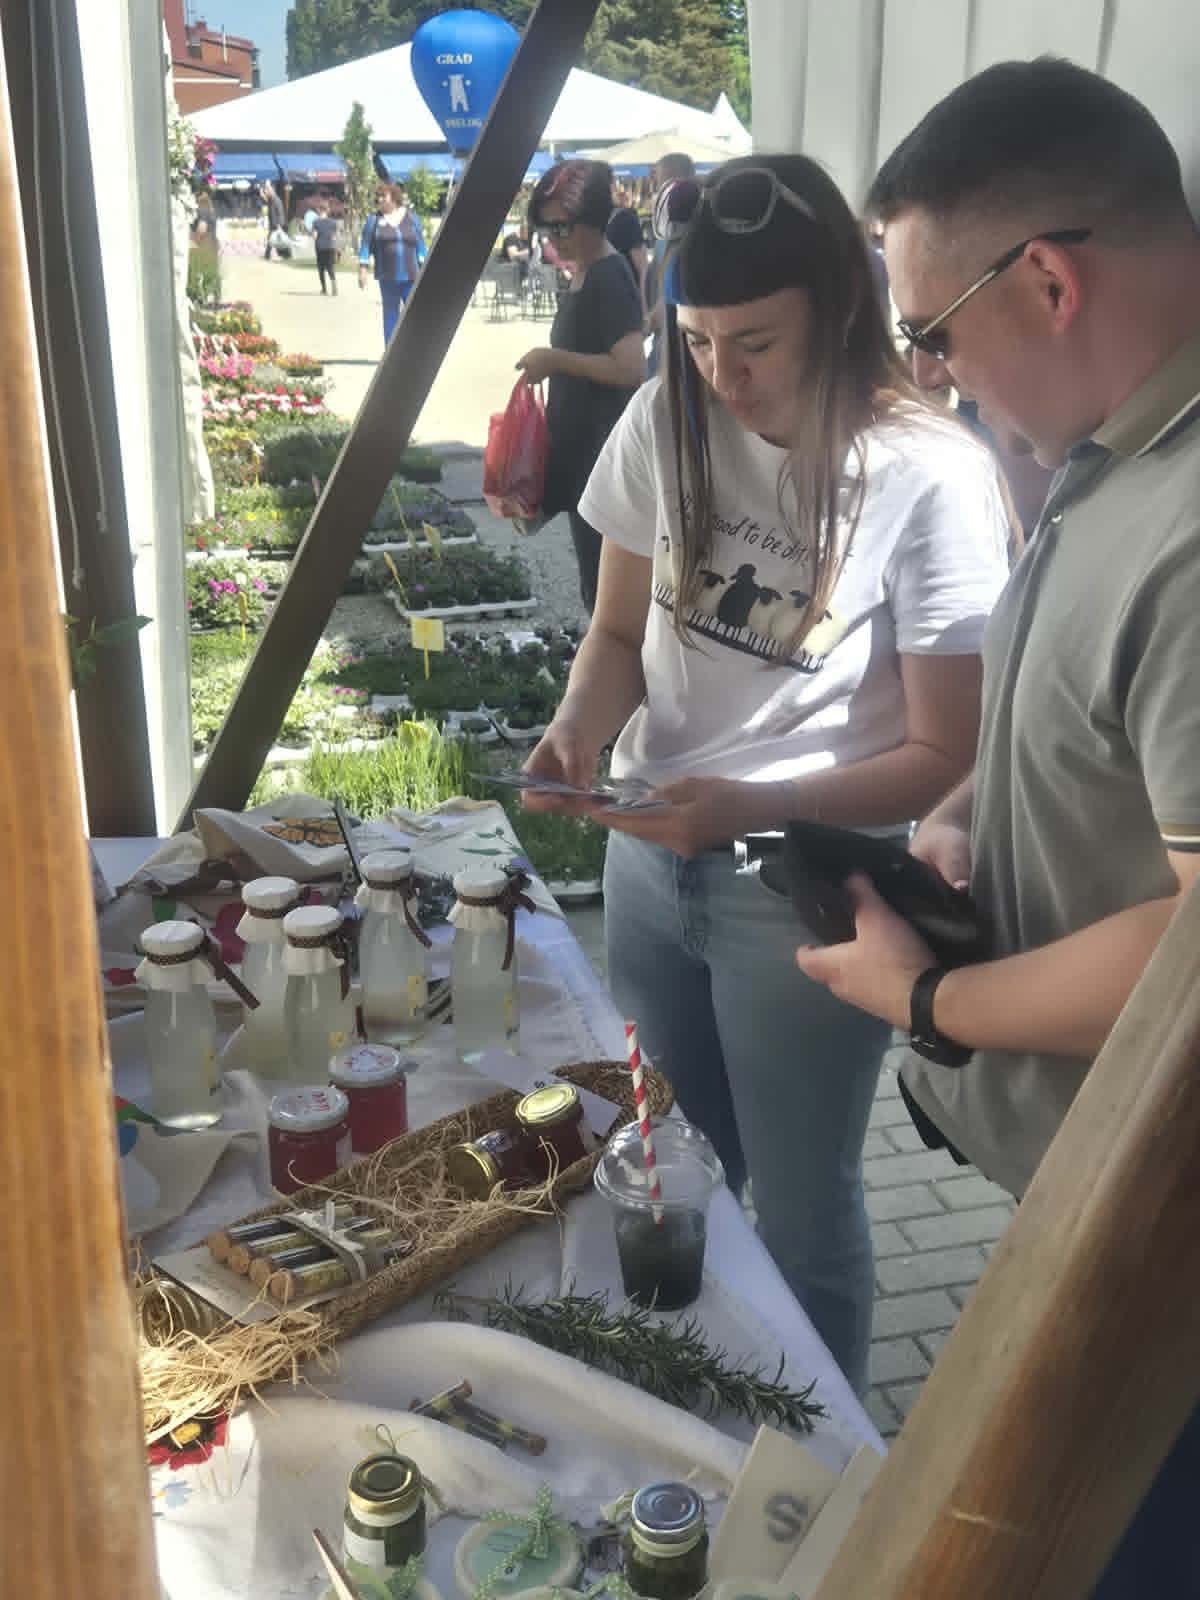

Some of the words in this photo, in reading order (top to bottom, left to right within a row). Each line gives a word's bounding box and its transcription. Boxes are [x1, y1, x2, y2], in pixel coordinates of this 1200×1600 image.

[435, 53, 473, 65] GRAD
[711, 514, 750, 537] ood
[743, 522, 761, 545] to
[760, 528, 781, 554] be
